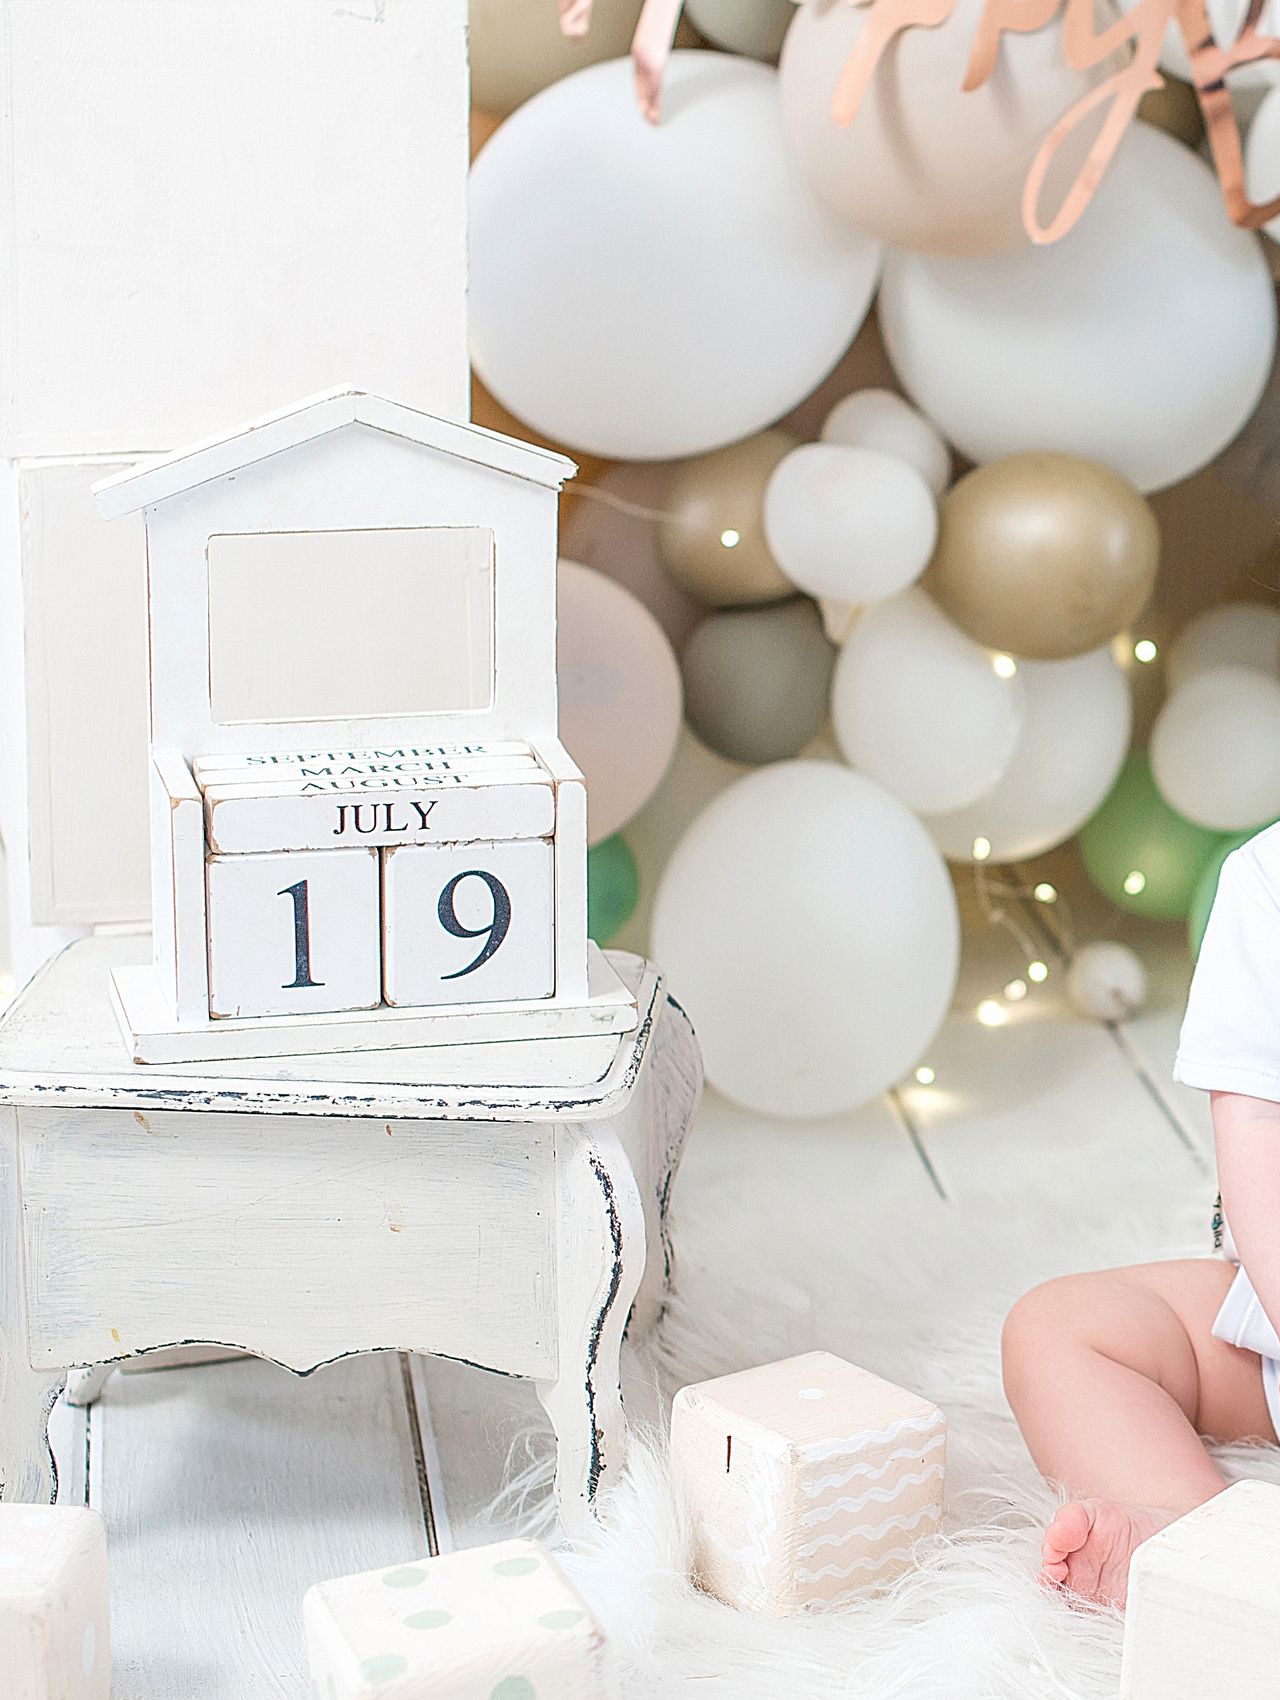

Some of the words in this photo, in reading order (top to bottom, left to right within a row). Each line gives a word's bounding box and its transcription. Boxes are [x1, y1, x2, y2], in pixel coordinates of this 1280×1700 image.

[246, 745, 488, 765] SEPTEMBER
[301, 761, 451, 776] MARCH
[301, 774, 468, 791] AUGUST
[333, 801, 439, 835] JULY
